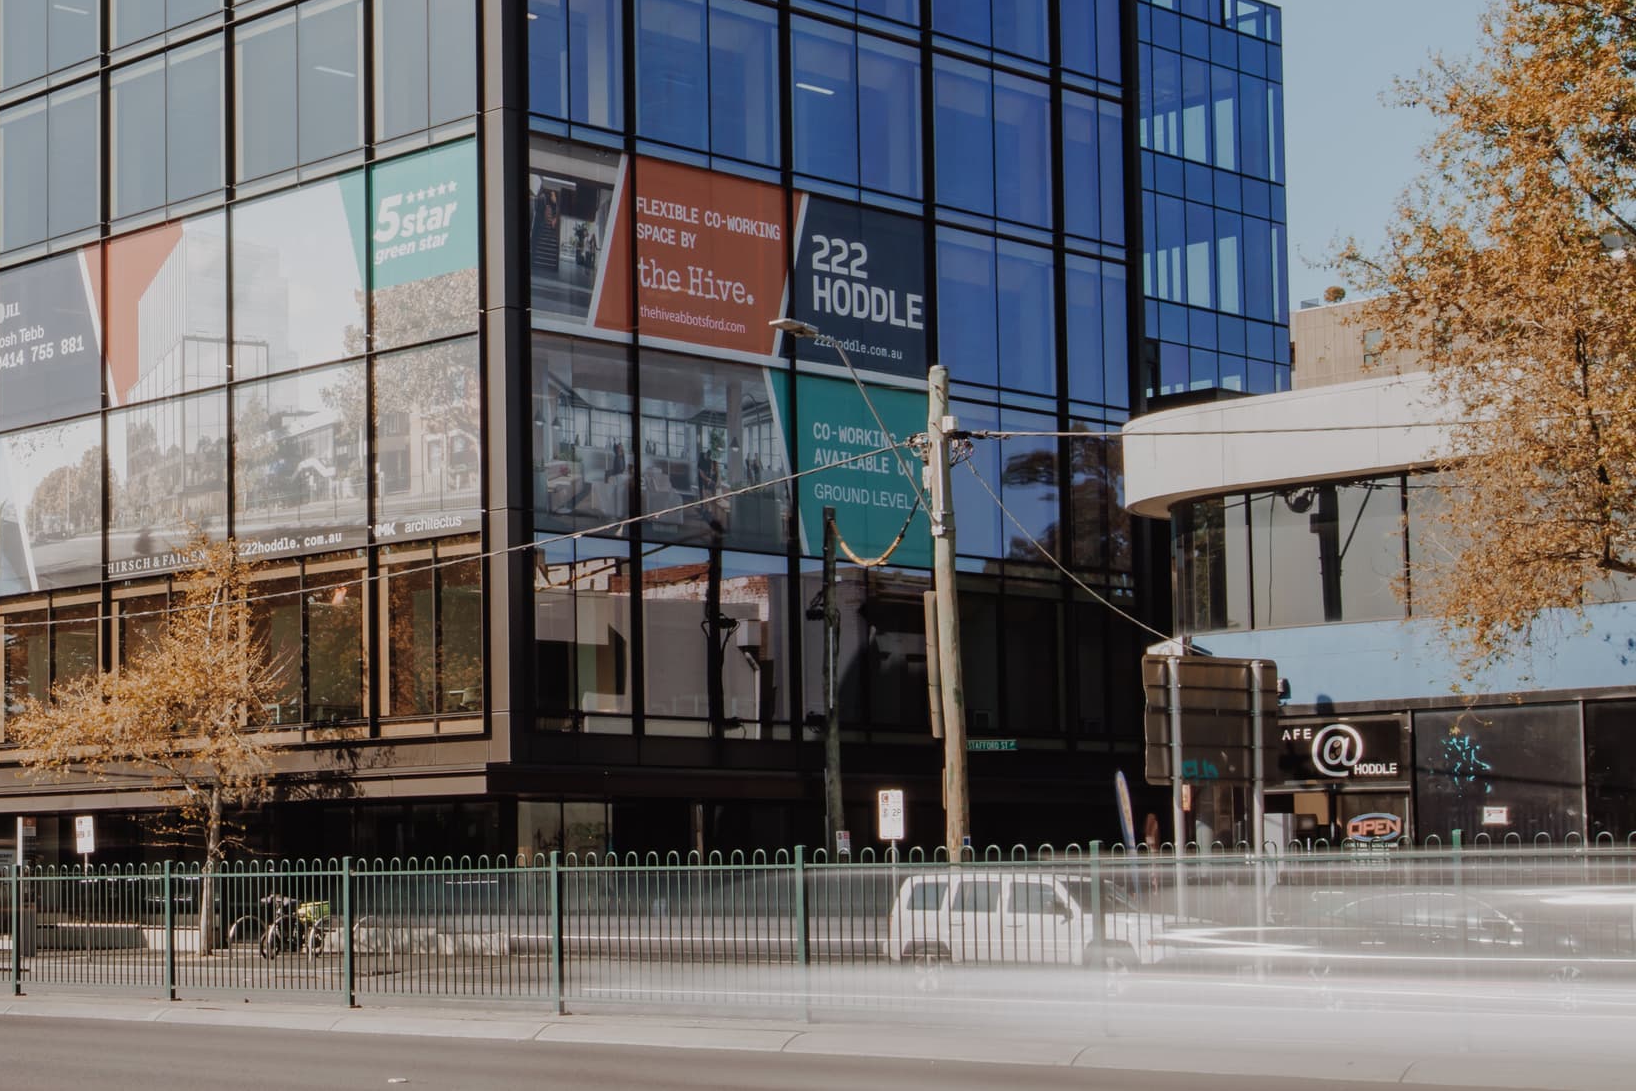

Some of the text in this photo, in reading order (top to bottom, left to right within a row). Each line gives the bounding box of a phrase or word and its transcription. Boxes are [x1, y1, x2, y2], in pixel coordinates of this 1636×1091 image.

[636, 196, 781, 240] FLEXIBLE CO-WORKING
[374, 232, 449, 265] green star
[636, 222, 697, 249] SPACE BY
[811, 234, 868, 279] 222
[637, 256, 754, 305] the Hive.
[4, 302, 20, 318] JLL
[812, 275, 924, 330] HODDLE
[640, 304, 746, 333] thehiveabbotsford.com
[19, 324, 44, 343] Tebb
[31, 342, 54, 363] 755
[60, 334, 84, 355] 881
[813, 422, 897, 448] CO-WORKING
[814, 448, 914, 476] AVAILABLE ON
[814, 483, 870, 505] GROUND
[872, 490, 913, 510] LEVEL
[404, 515, 462, 534] architectus
[107, 557, 151, 575] HIRSCH
[1282, 728, 1312, 741] AFE
[1354, 763, 1398, 775] HODDLE
[1347, 817, 1401, 837] OPEN
